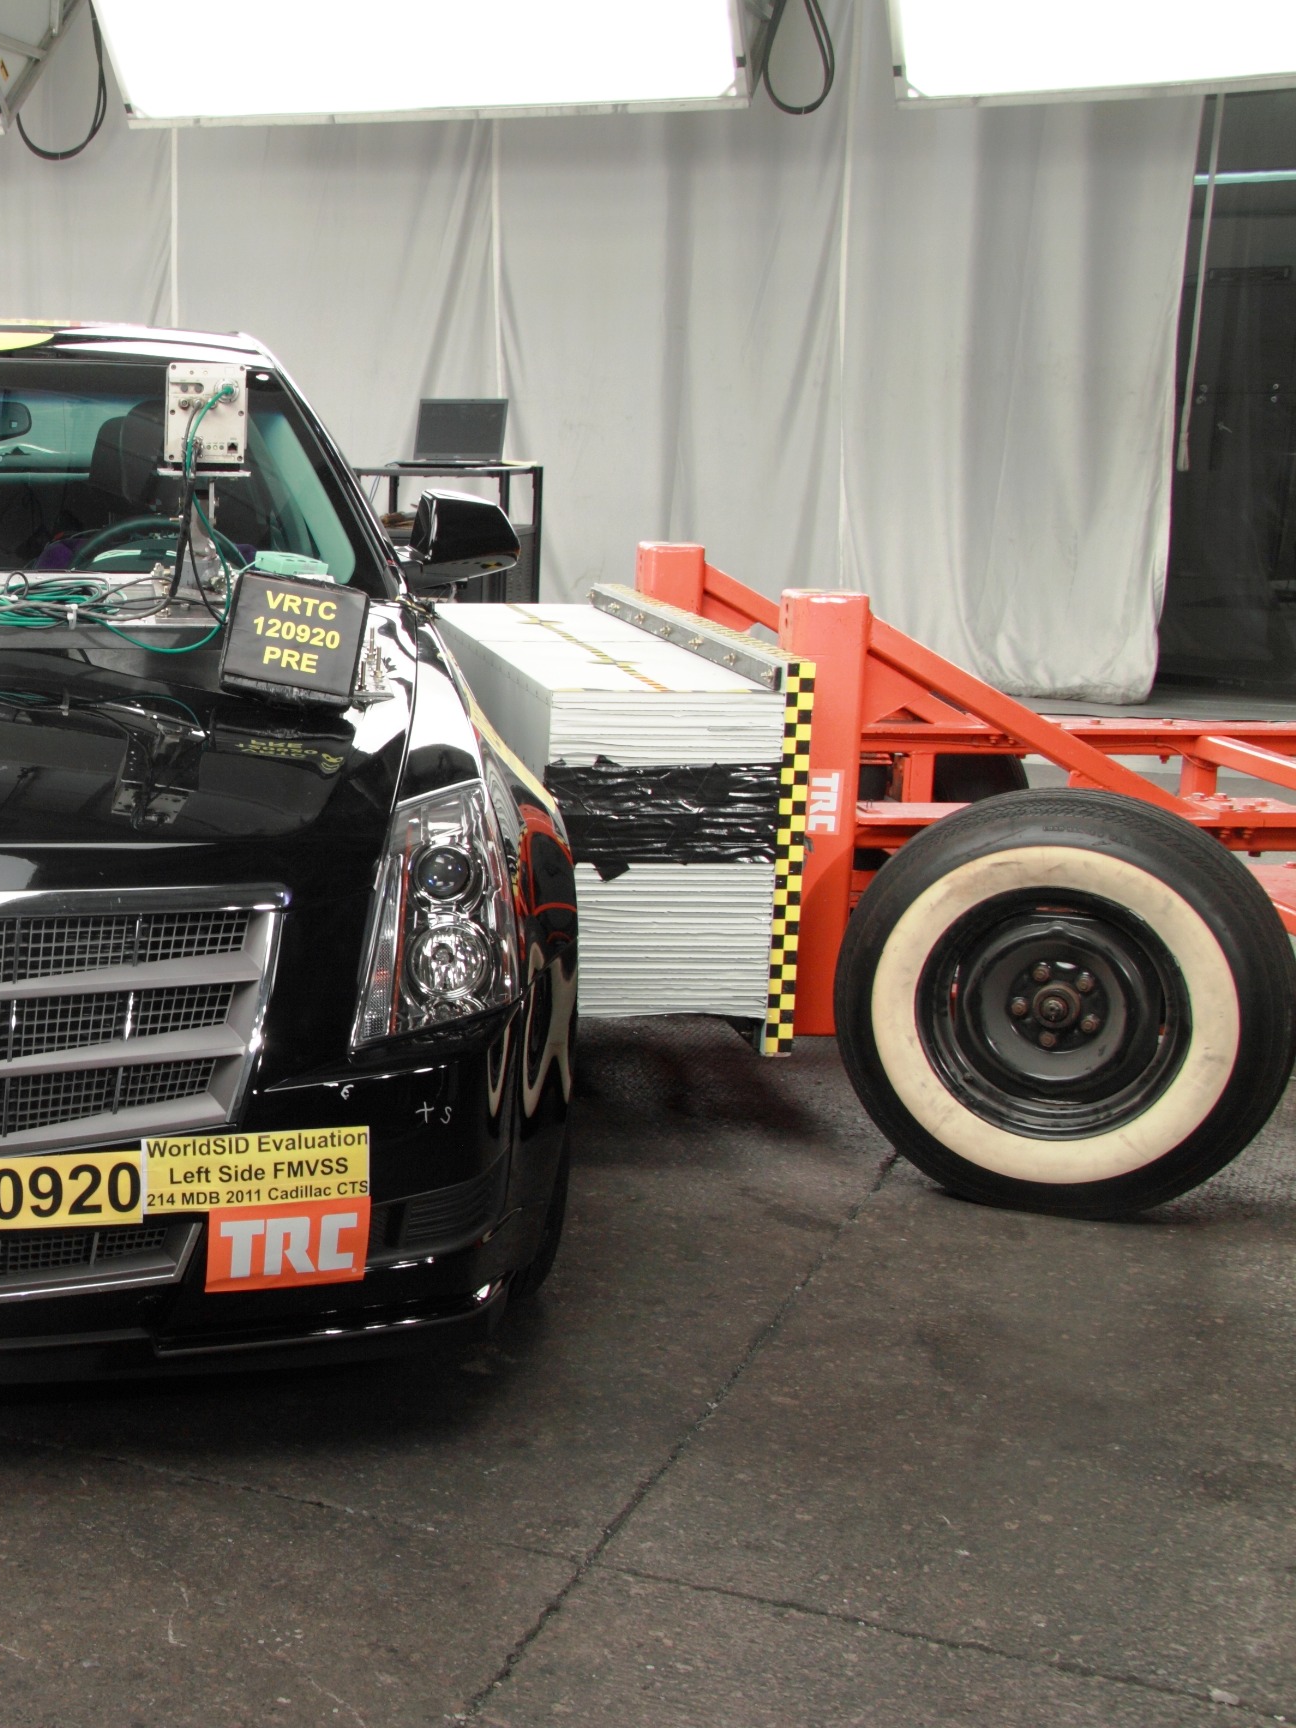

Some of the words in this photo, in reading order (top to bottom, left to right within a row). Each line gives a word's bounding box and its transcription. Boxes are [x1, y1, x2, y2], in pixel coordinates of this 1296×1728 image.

[266, 590, 337, 621] VRTC
[253, 616, 340, 649] 120920
[262, 646, 319, 674] PRE
[807, 772, 840, 832] TRC
[146, 1136, 250, 1158] WorldSID
[257, 1130, 368, 1153] Evaluation
[169, 1166, 211, 1185] Left
[218, 1164, 266, 1183] Side
[273, 1157, 349, 1179] FMVSS
[147, 1193, 176, 1207] 214
[181, 1191, 220, 1206] MDB
[226, 1188, 262, 1204] 2011
[267, 1184, 332, 1201] Cadillac
[336, 1180, 368, 1196] CTS
[220, 1212, 358, 1279] TRC
